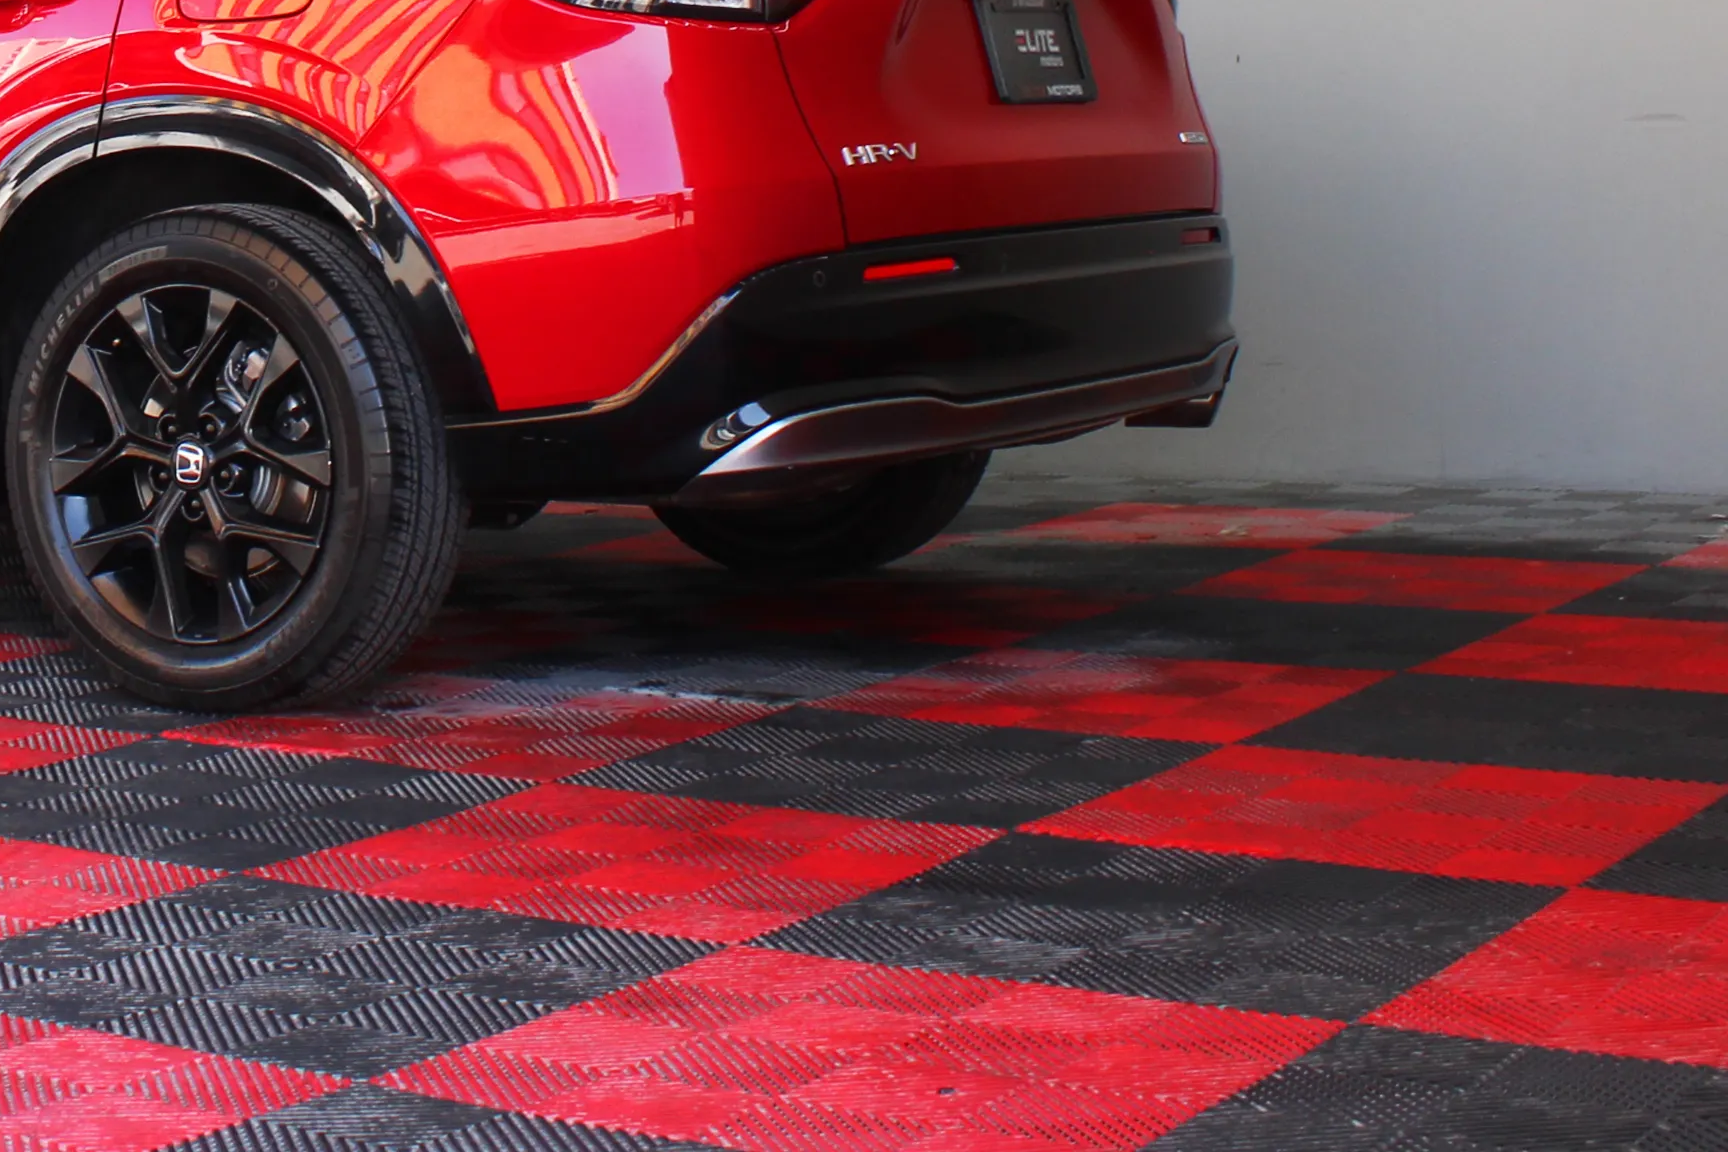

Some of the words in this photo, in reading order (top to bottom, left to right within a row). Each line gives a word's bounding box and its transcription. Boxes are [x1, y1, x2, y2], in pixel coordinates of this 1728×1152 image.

[1014, 29, 1061, 53] ELITE
[841, 142, 917, 166] HR-V
[28, 279, 95, 395] MICHELIN
